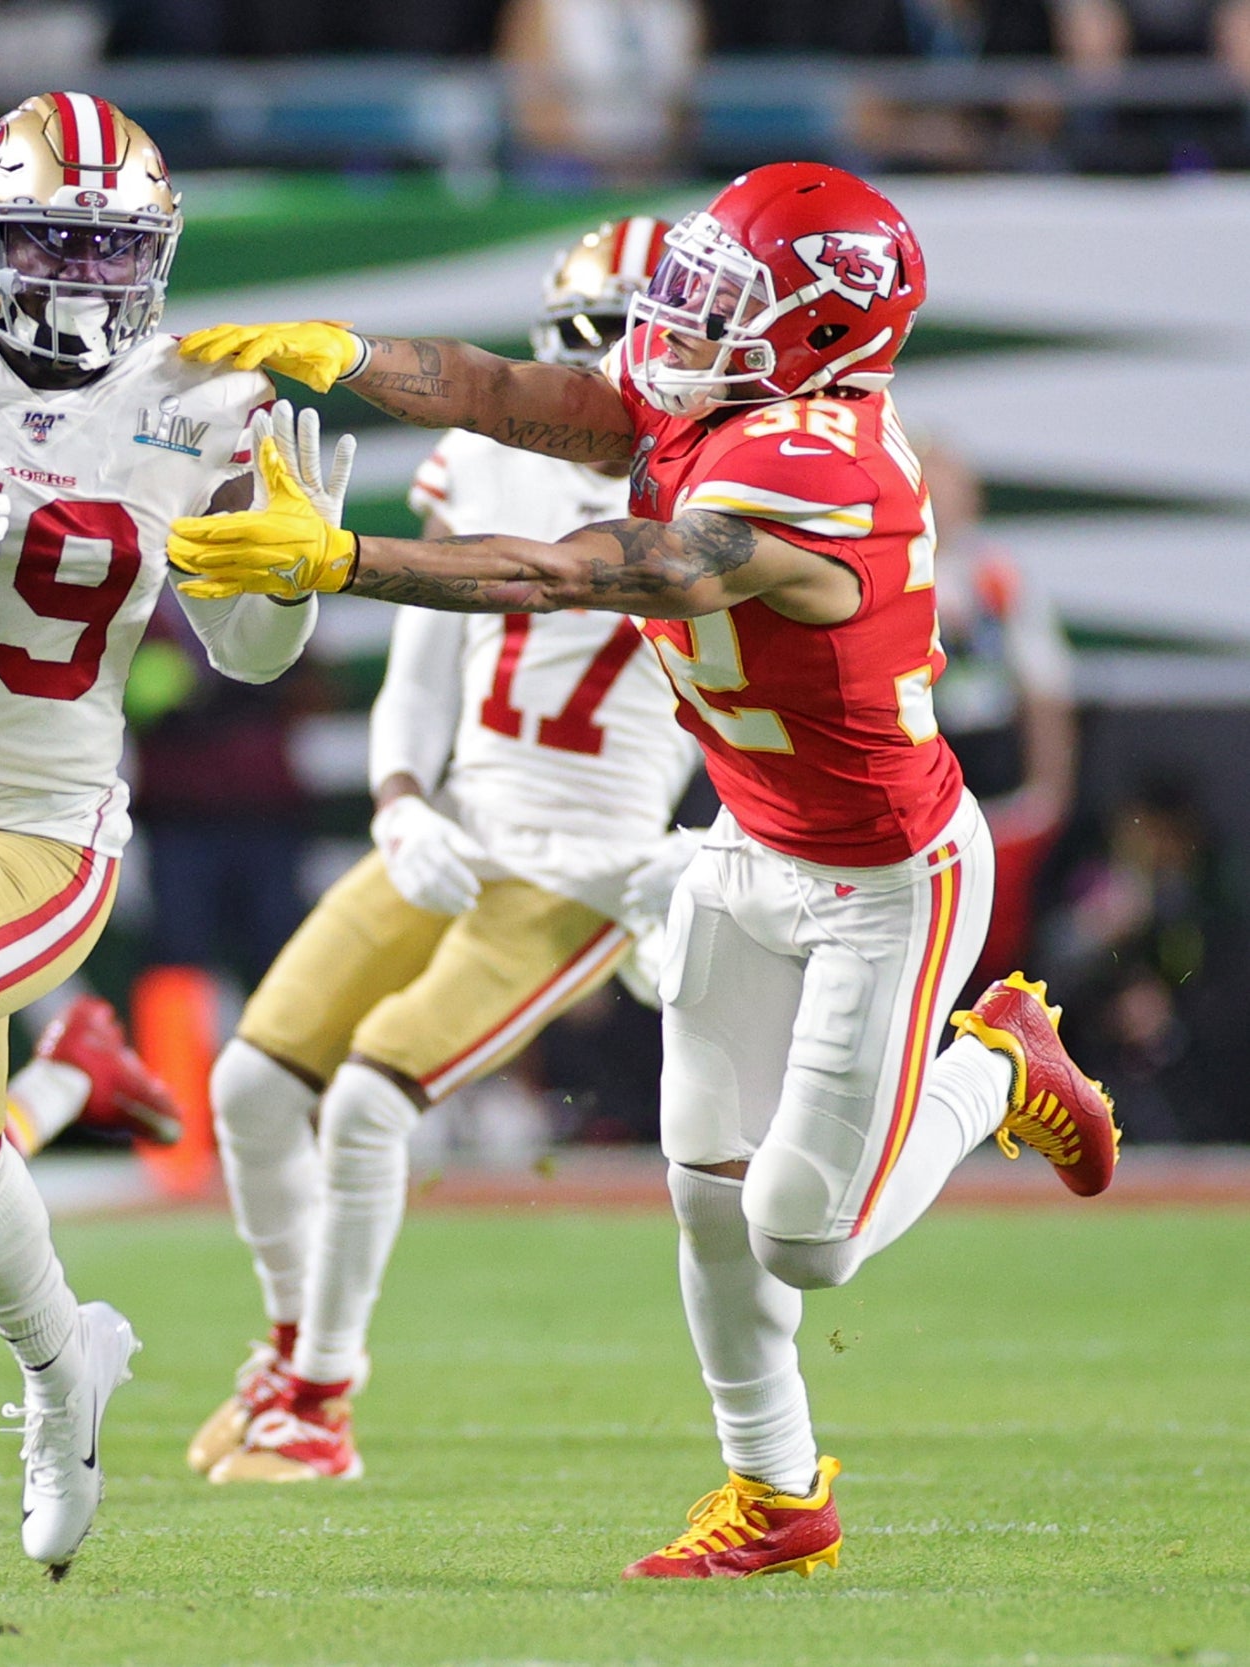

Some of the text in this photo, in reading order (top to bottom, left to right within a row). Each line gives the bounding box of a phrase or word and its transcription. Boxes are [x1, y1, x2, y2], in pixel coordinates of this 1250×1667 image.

[816, 235, 884, 292] KC
[136, 405, 211, 449] LIV
[742, 399, 858, 457] 32
[3, 465, 78, 488] 49ERS
[480, 612, 643, 756] 17
